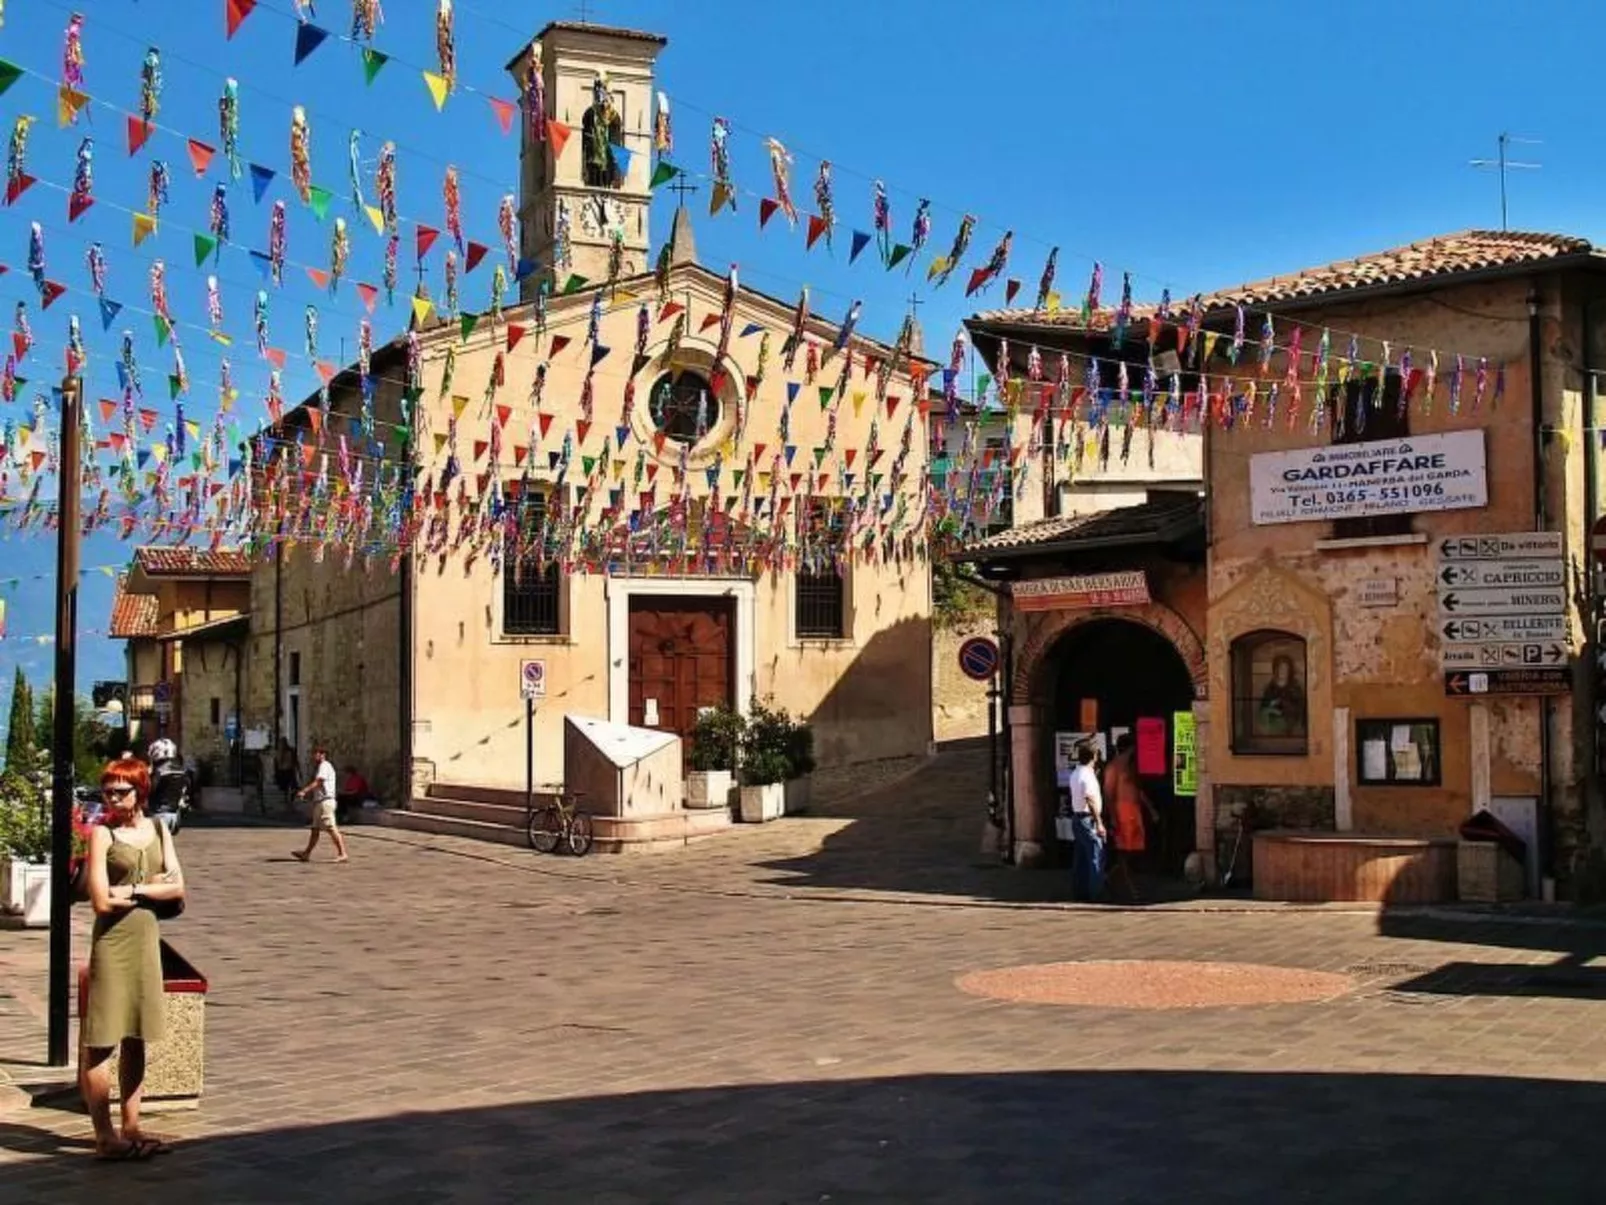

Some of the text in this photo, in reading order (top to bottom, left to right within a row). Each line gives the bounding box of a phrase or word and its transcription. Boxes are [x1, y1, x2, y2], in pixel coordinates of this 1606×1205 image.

[1283, 453, 1446, 482] GARDAFFARE
[1427, 469, 1472, 481] GARDA
[1288, 493, 1322, 507] Tel.
[1483, 571, 1561, 584] CAPRICCIO
